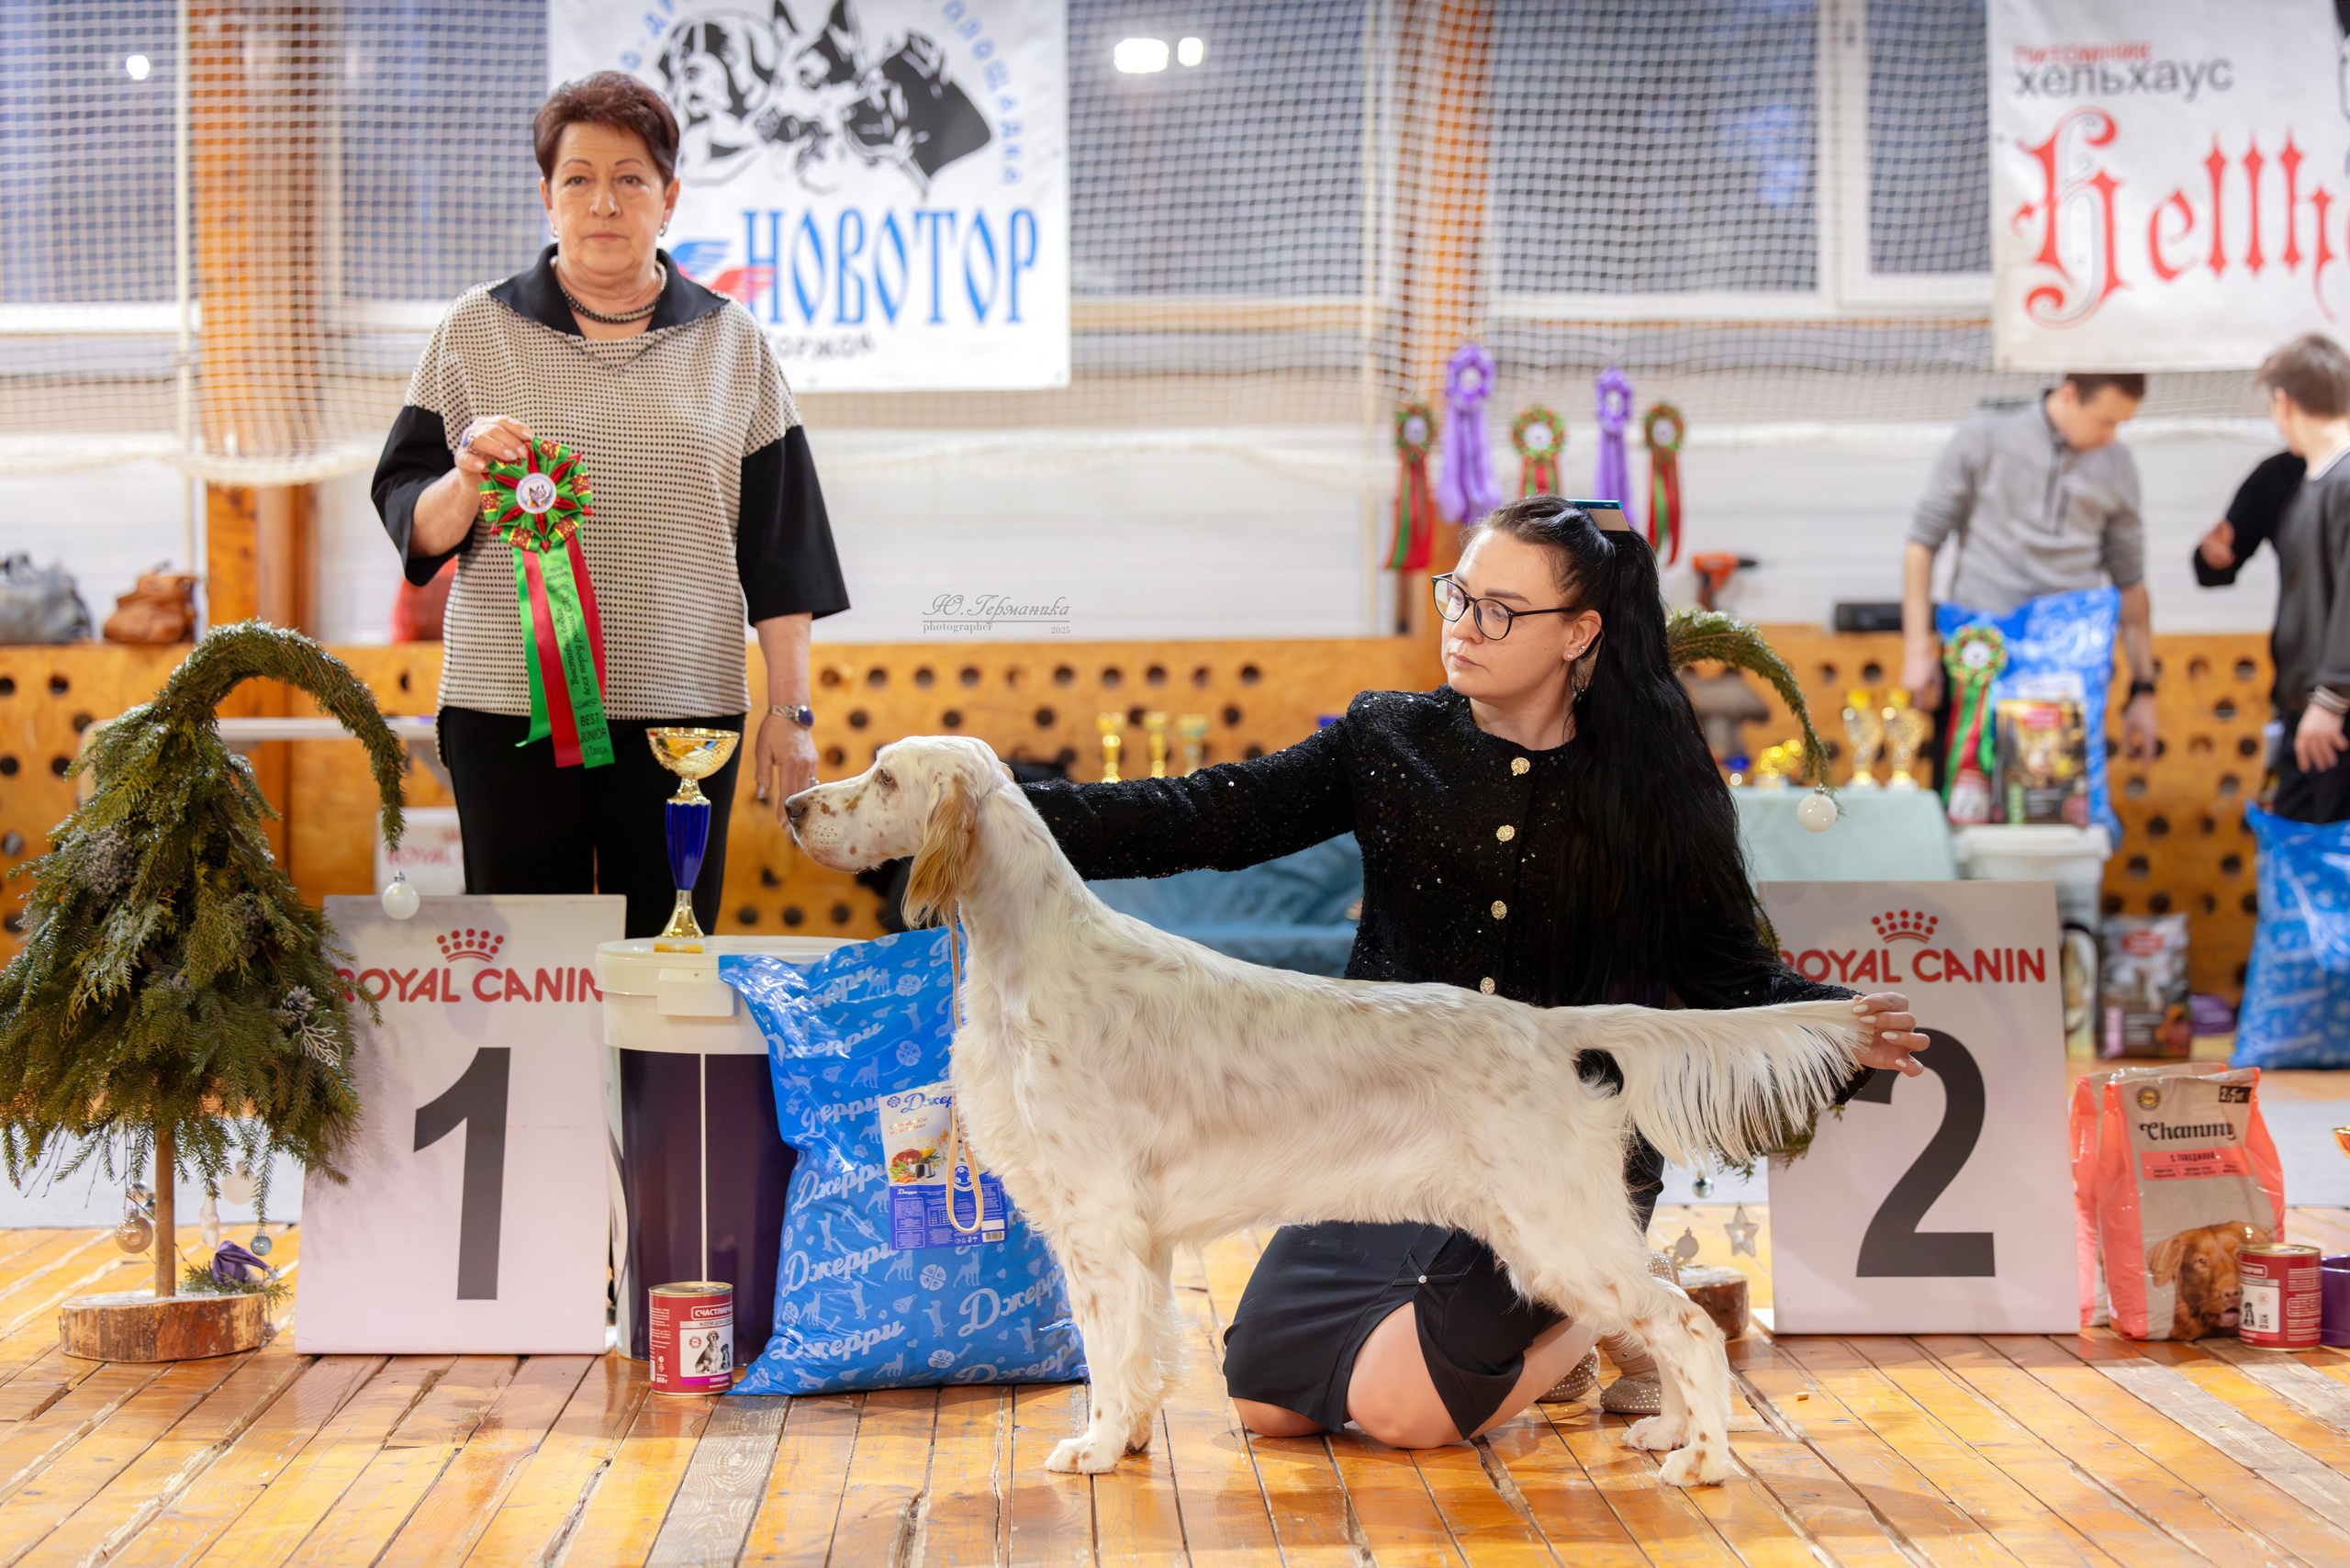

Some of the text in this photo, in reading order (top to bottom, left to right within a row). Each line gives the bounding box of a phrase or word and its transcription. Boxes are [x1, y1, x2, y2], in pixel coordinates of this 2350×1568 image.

[2010, 106, 2350, 330] Hellh
[742, 207, 1038, 326] НОВОТОР
[580, 712, 599, 727] BEST
[580, 728, 608, 743] JUNIOR
[472, 967, 604, 1002] CANIN
[1912, 947, 2045, 983] CANIN
[901, 1092, 952, 1114] Джер
[414, 1047, 510, 1300] 1
[1854, 1027, 1996, 1277] 2
[790, 1162, 887, 1215] Джерри
[781, 1242, 901, 1298] Джерри
[768, 1320, 906, 1361] Джерри
